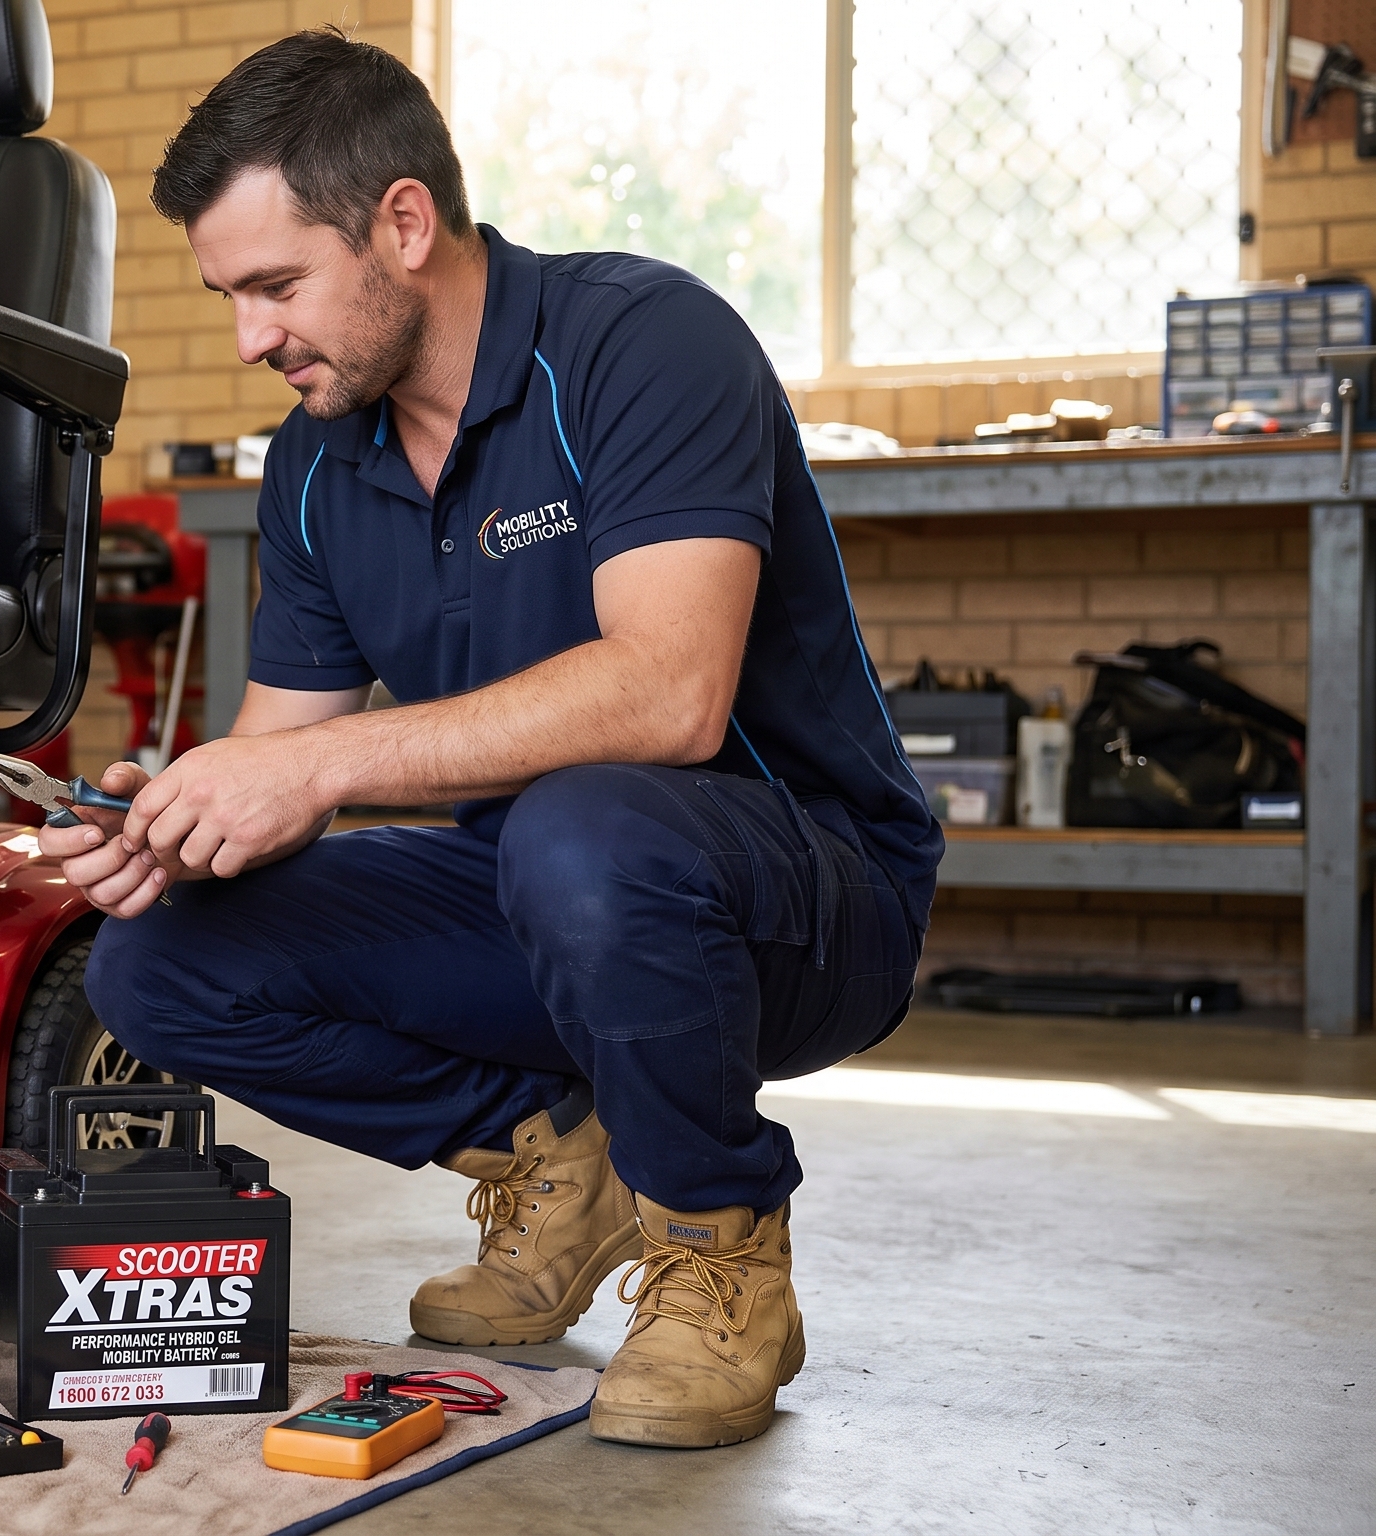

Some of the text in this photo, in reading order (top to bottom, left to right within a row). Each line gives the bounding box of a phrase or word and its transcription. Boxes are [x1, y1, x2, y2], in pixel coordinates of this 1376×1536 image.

[495, 499, 569, 538] MOBILITY
[500, 517, 578, 553] SOLUTIONS
[116, 1243, 258, 1276] SCOOTER
[48, 1268, 253, 1324] XTRAS
[71, 1330, 242, 1350] PERFORMANCE HYBRID GEL
[102, 1349, 162, 1365] MOBILITY
[163, 1346, 219, 1362] BATTERY
[58, 1384, 164, 1404] 1800 672 033
